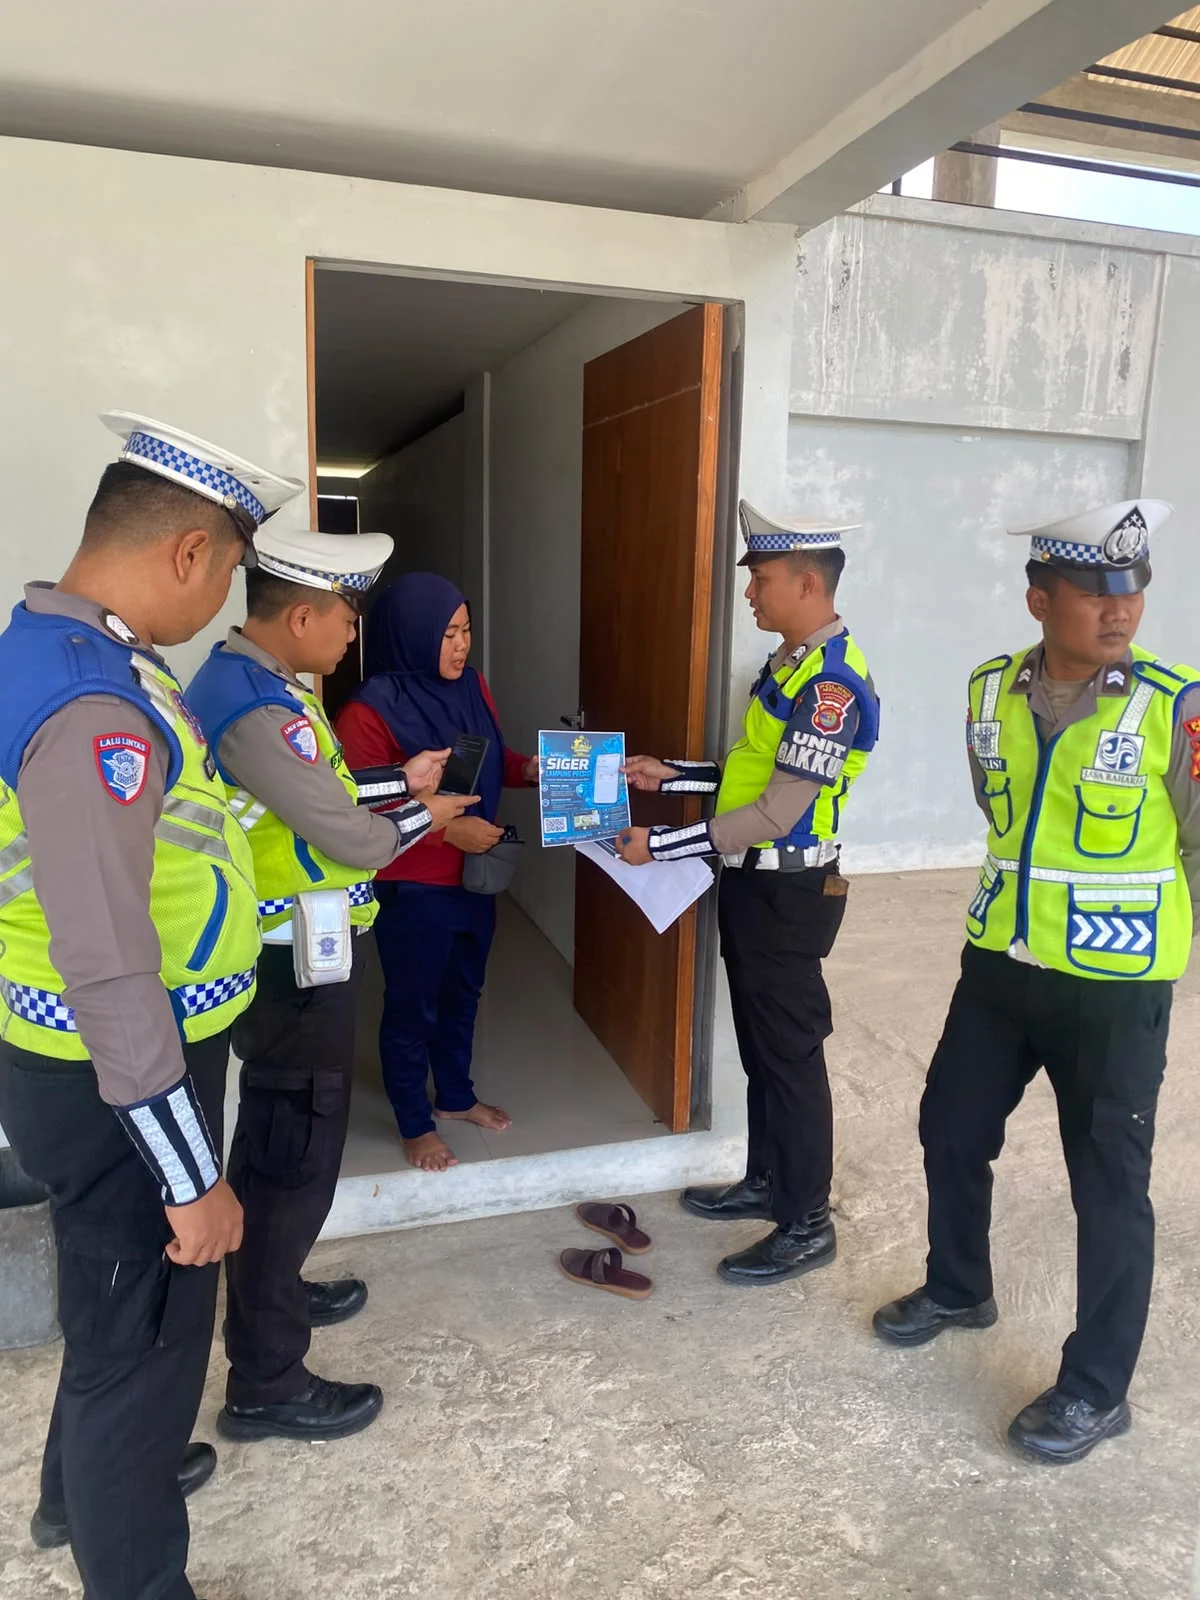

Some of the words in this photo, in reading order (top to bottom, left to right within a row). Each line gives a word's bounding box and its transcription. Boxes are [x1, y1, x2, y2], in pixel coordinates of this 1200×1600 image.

[100, 737, 121, 748] LALU
[121, 737, 146, 751] LINTAS
[793, 731, 847, 757] UNIT
[546, 757, 589, 770] SIGER
[776, 741, 845, 780] GAKKU
[1083, 769, 1104, 780] JASA
[1106, 773, 1143, 785] RAHARJA
